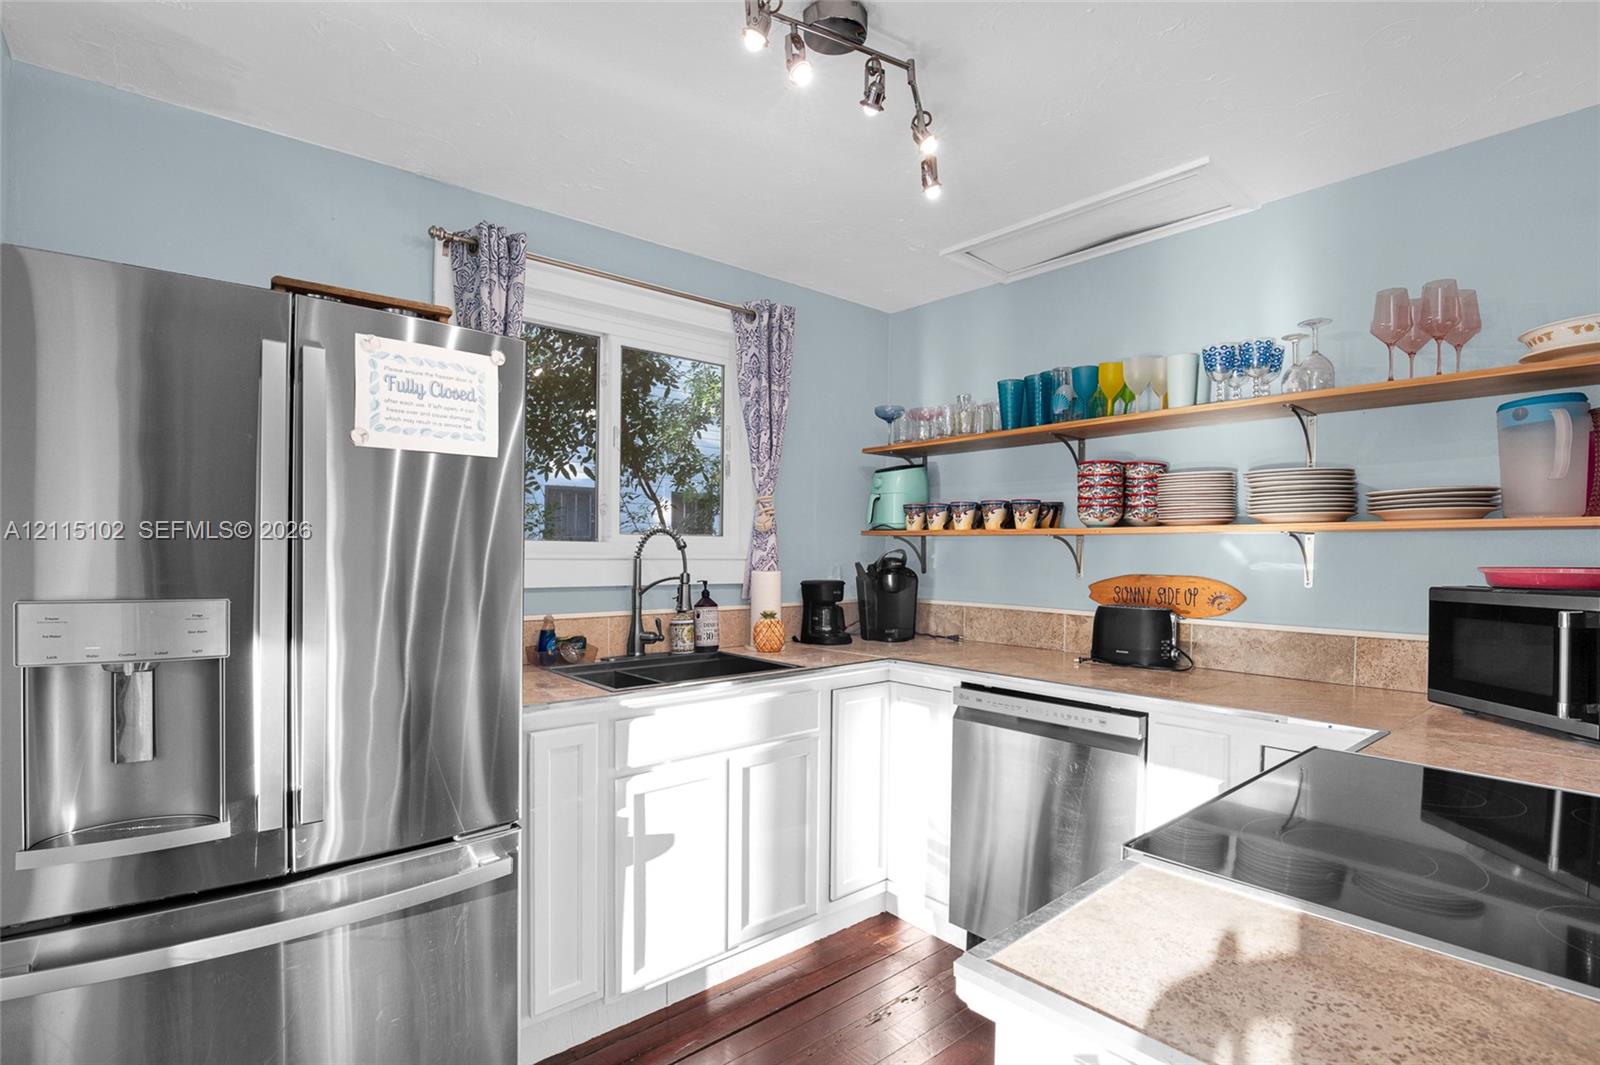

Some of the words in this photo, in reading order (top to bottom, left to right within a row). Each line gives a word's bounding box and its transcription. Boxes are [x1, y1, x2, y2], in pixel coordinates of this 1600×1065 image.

[384, 374, 427, 400] Fully
[429, 380, 477, 403] Closed
[1112, 586, 1152, 605] SUNNY
[1155, 586, 1182, 606] SIDE
[1184, 587, 1199, 607] UP
